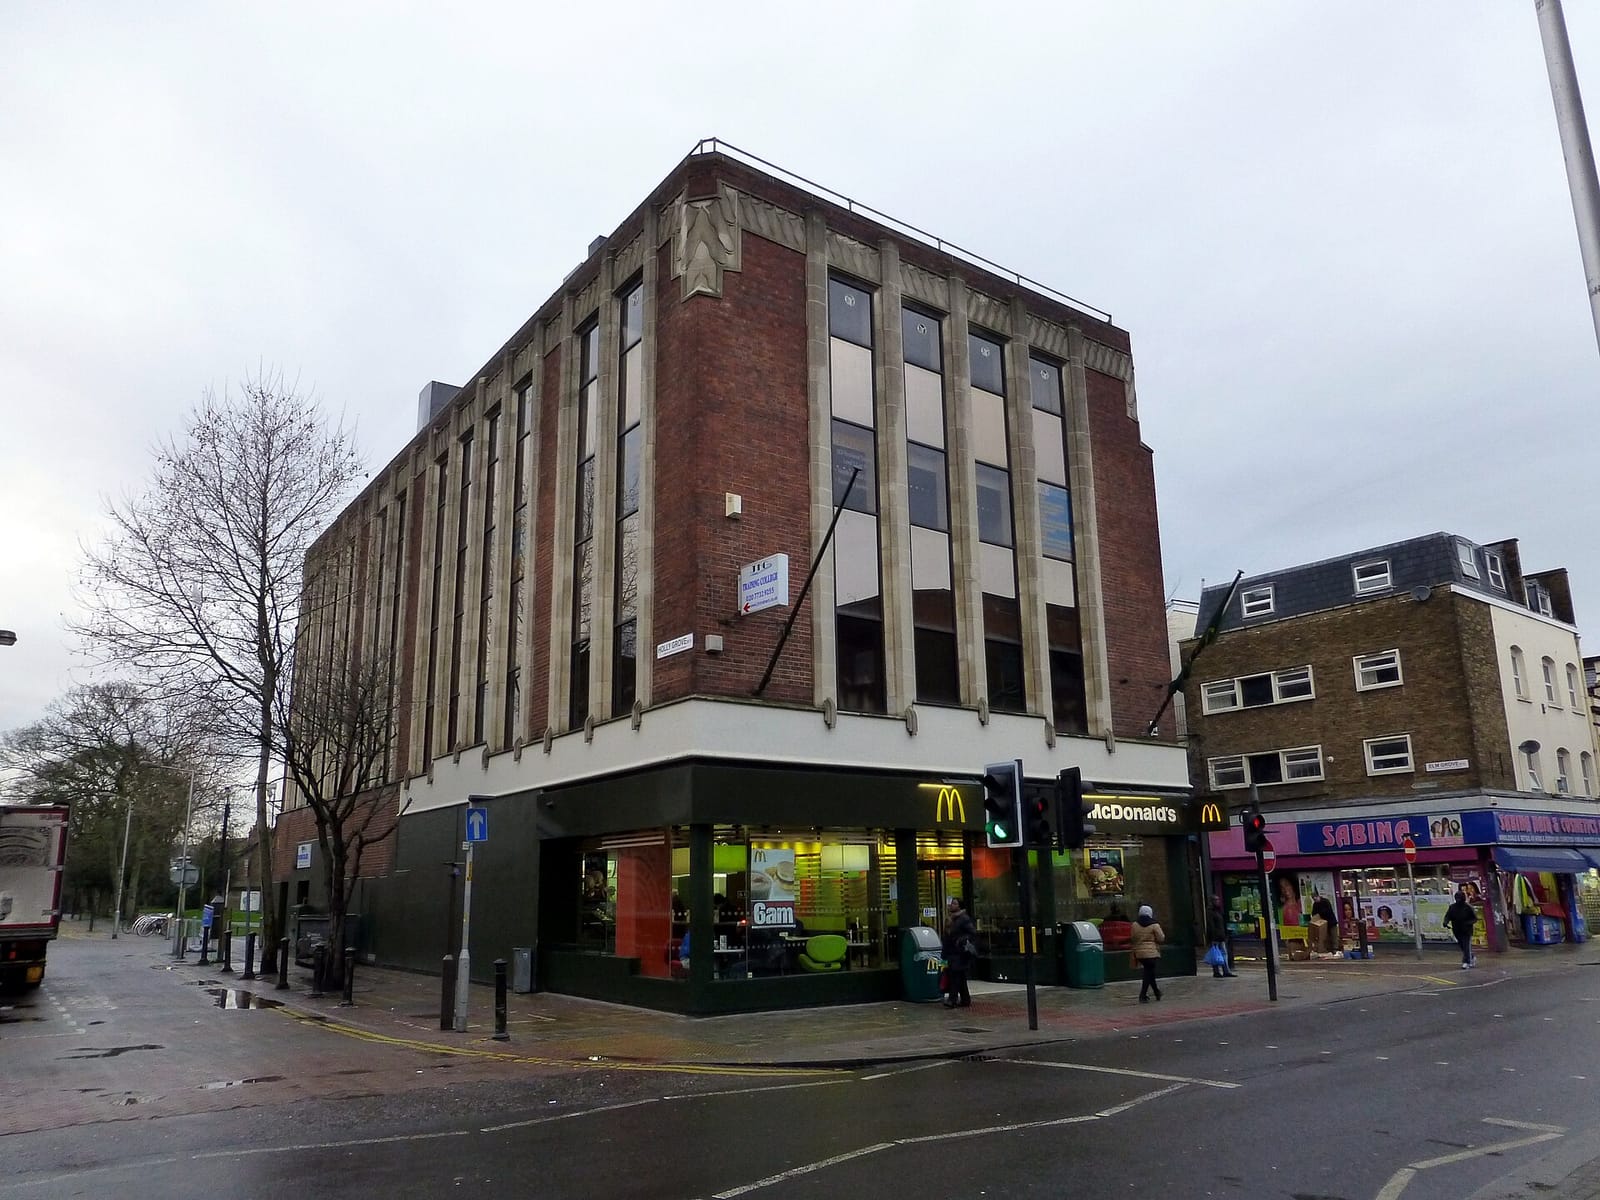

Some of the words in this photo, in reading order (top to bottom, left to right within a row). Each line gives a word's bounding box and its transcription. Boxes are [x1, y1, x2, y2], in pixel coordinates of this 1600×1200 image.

[672, 637, 688, 648] GROVE
[1087, 803, 1176, 822] McDonald's
[1322, 820, 1409, 848] SABINA
[753, 902, 794, 924] 6am
